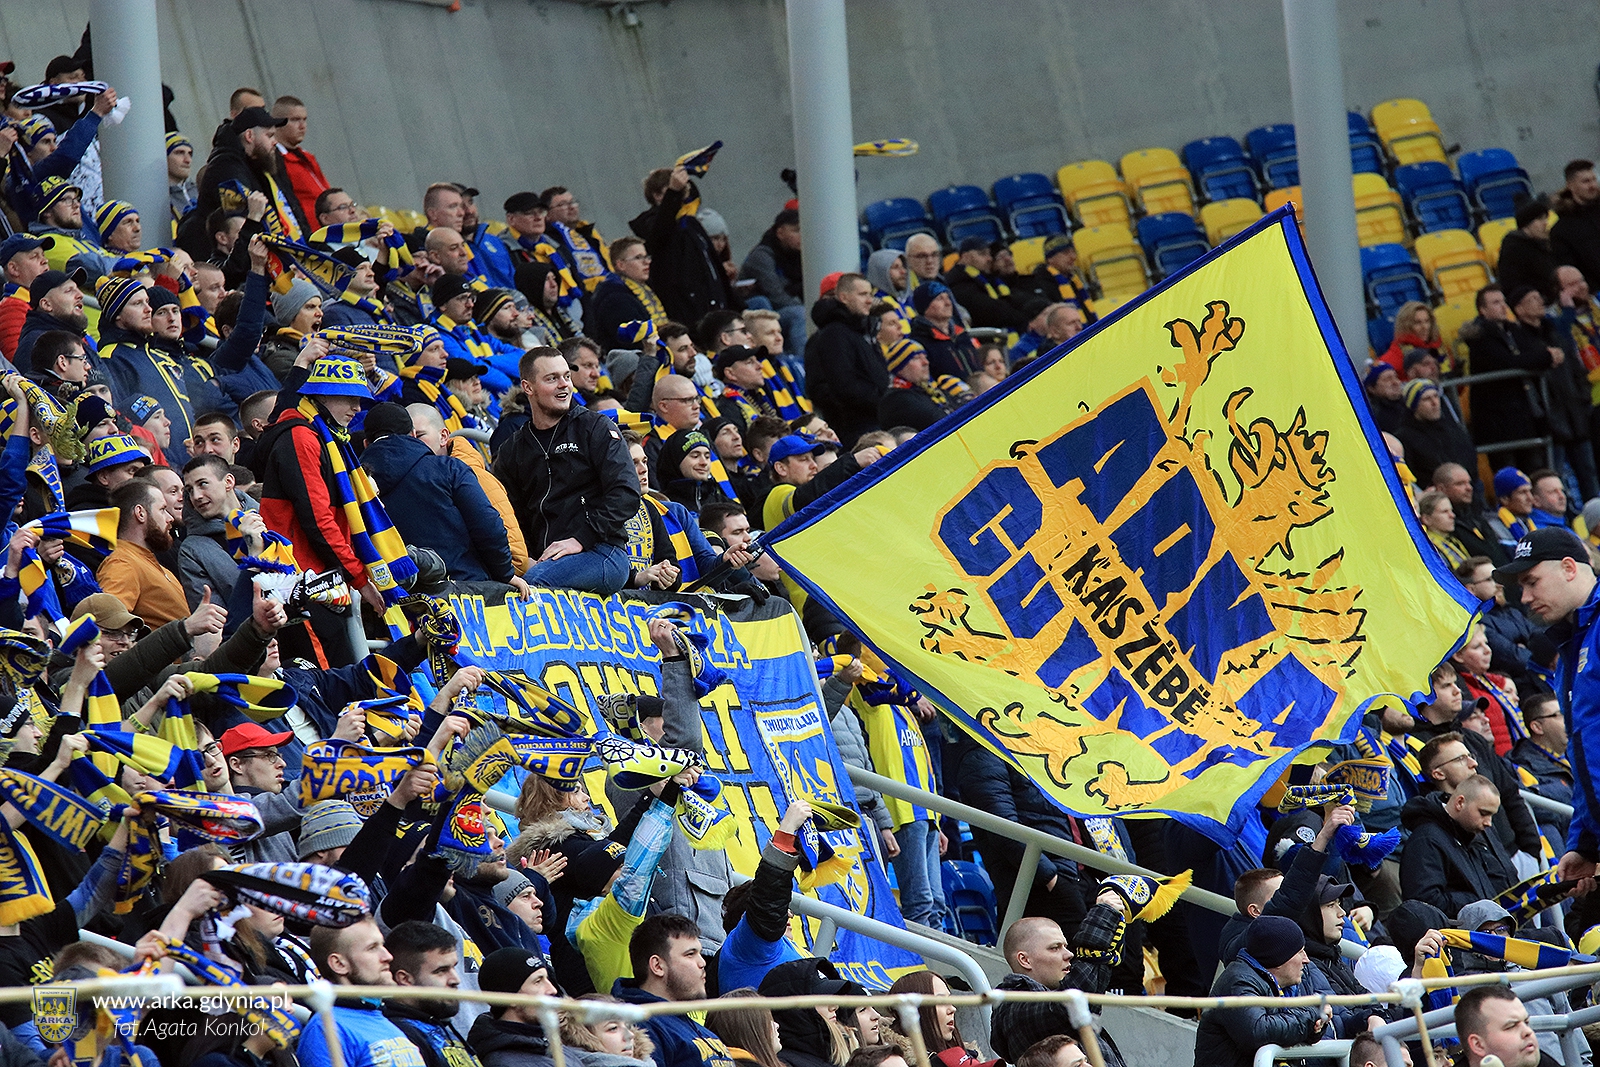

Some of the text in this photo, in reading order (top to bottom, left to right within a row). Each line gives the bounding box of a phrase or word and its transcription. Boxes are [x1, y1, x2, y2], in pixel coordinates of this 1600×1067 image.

[313, 363, 354, 380] ZKS
[91, 441, 117, 459] KA
[1036, 386, 1339, 749] ARKA
[450, 596, 493, 654] W
[506, 591, 661, 661] JEDNOŚC
[1062, 543, 1211, 725] KASZËBË
[353, 793, 382, 801] ARKA
